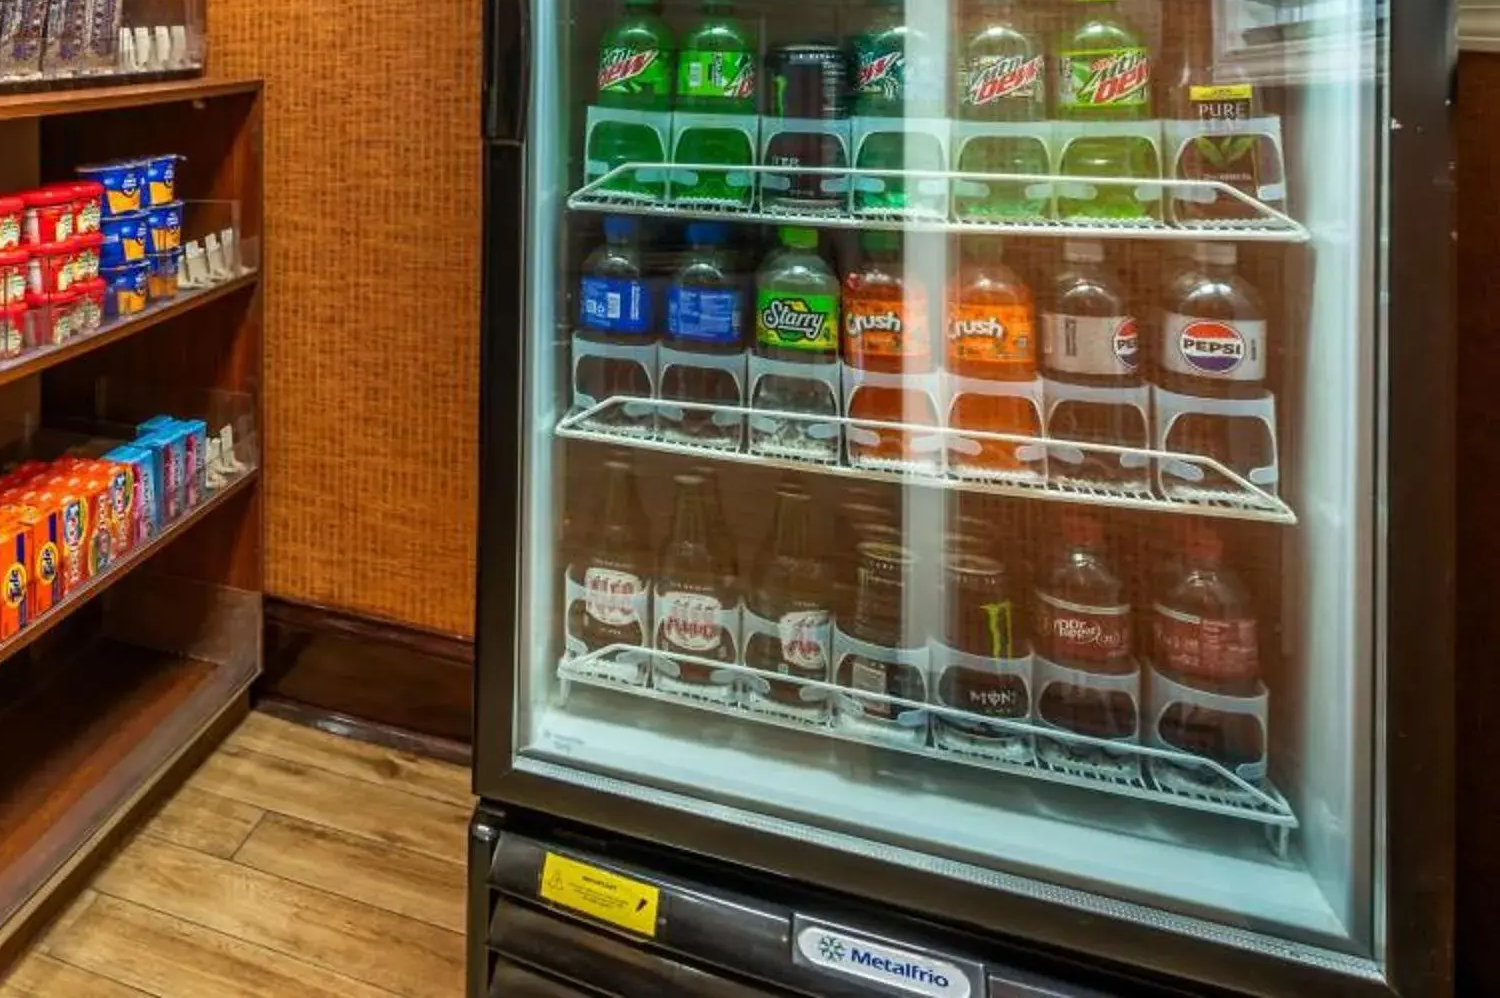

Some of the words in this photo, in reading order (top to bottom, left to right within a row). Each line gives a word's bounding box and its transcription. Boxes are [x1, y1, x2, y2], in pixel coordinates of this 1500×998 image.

[1199, 102, 1247, 117] PURE
[763, 300, 826, 338] Starry
[1183, 338, 1242, 356] PEPSI
[850, 948, 950, 988] Metalfrio
